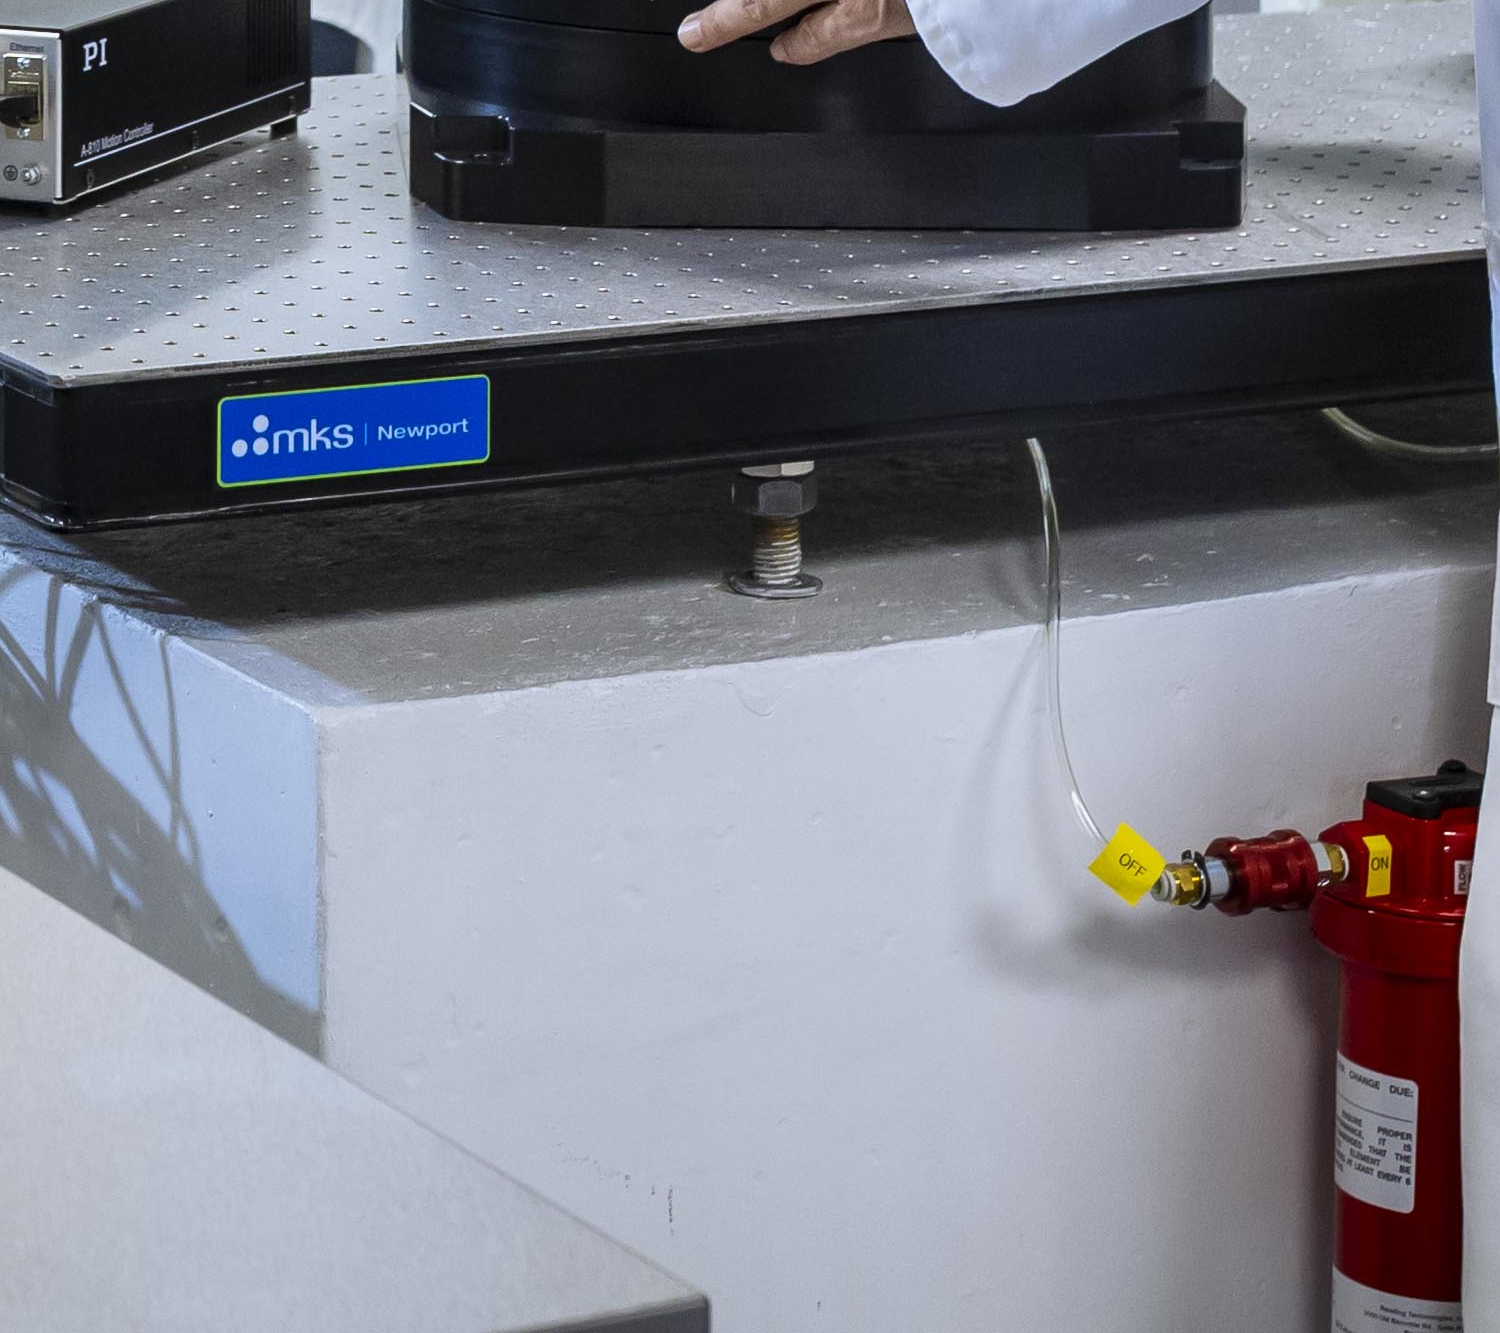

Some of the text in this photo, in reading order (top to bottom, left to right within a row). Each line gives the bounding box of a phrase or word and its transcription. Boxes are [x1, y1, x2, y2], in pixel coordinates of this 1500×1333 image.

[9, 42, 45, 53] Ethernet
[82, 37, 108, 72] PI
[101, 133, 123, 150] Motion
[123, 122, 154, 143] Controller
[272, 417, 470, 455] mks Newport
[1119, 853, 1148, 876] OFF
[1370, 856, 1389, 871] ON
[1457, 863, 1466, 891] FLOW
[1349, 1070, 1414, 1098] CHANGE DUE:
[1377, 1125, 1413, 1141] PROPER
[1350, 1148, 1381, 1167] ELEMENT
[1399, 1164, 1411, 1175] BE
[1368, 1144, 1412, 1164] THAT THE
[1354, 1161, 1375, 1176] LEAST
[1377, 1170, 1403, 1183] EVERY
